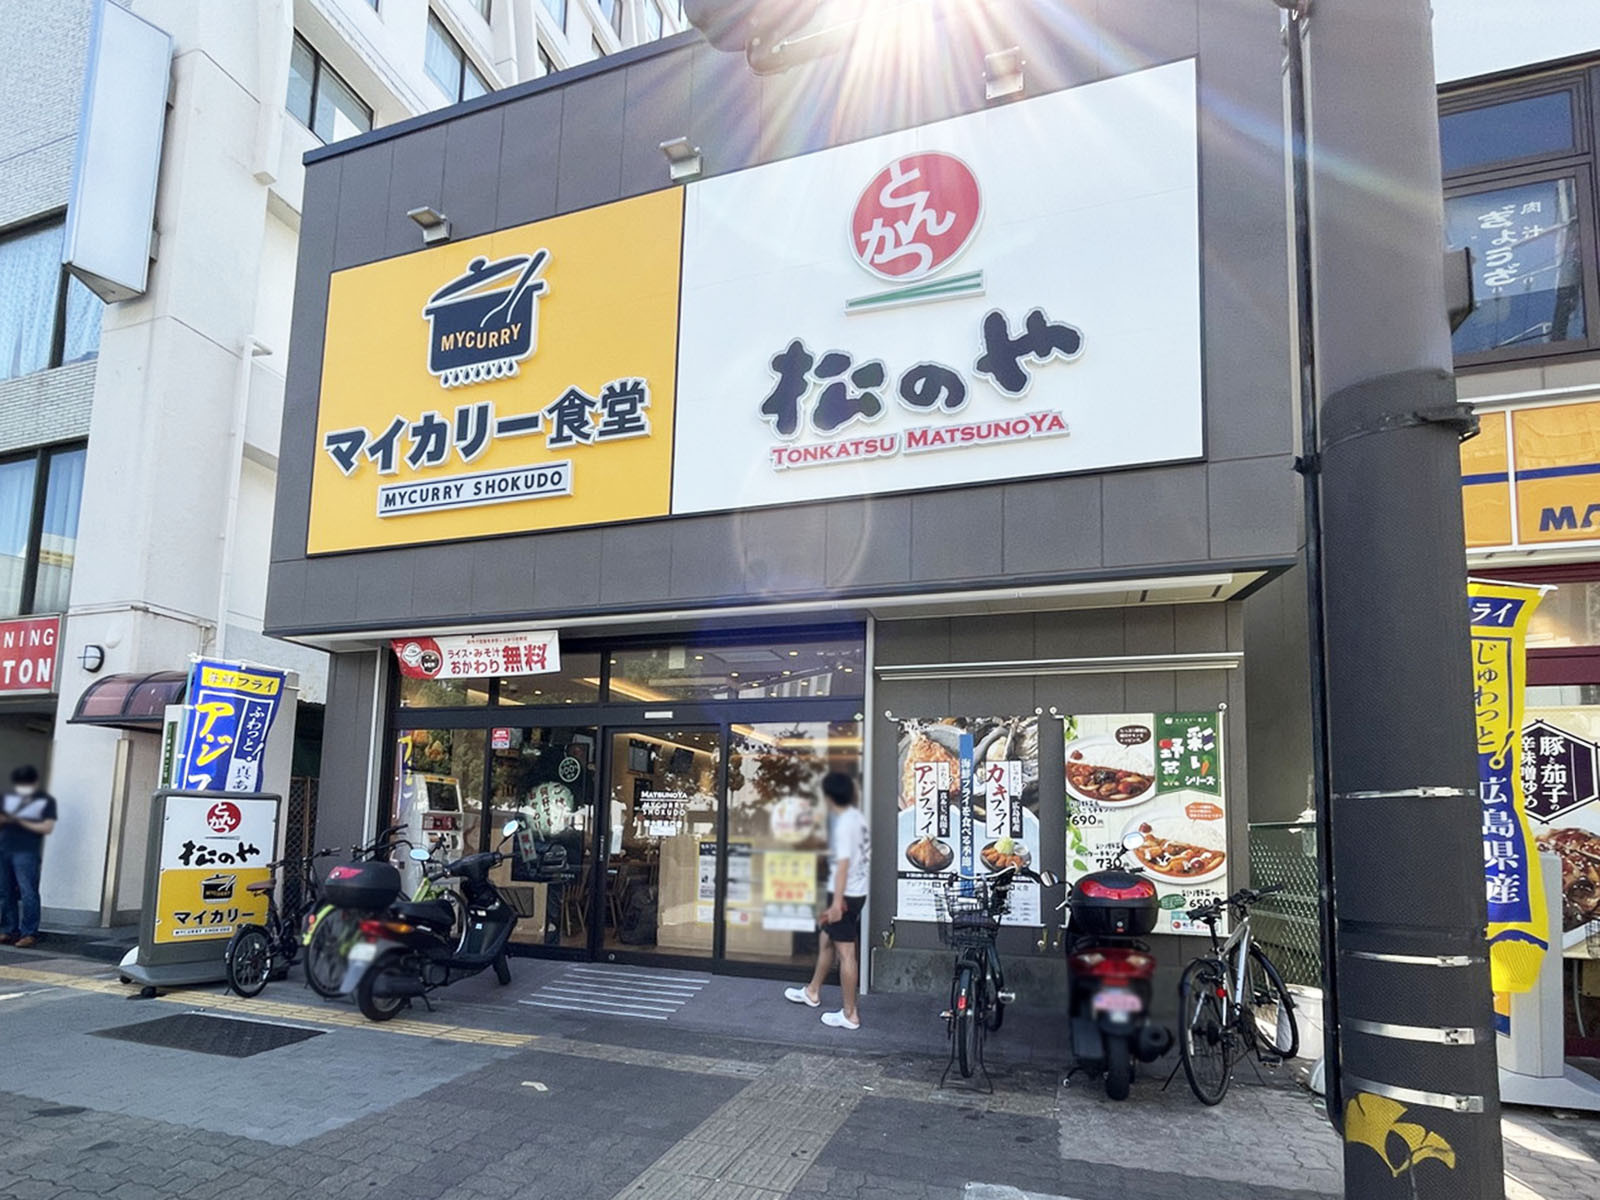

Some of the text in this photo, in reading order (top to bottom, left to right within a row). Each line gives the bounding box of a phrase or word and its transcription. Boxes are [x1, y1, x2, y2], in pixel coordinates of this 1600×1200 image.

[859, 159, 956, 278] とんかつ
[1520, 201, 1543, 239] 肉汁
[1478, 204, 1520, 287] ぎょうざ
[440, 323, 522, 352] MYCURRY
[760, 310, 1081, 435] 松のや
[325, 380, 648, 474] マイカリー食堂
[772, 413, 1066, 465] TONKATSU MATSUNOYA
[383, 470, 563, 508] MYCURRY SHOKUDO
[1471, 603, 1513, 624] ライ
[3, 628, 55, 649] NING
[447, 647, 500, 659] ライス・みそ汁
[3, 657, 52, 685] TON
[450, 658, 500, 675] おかわり
[502, 643, 548, 673] 無料
[914, 765, 936, 834] アジフライ
[985, 763, 1008, 835] カキフライ
[208, 802, 237, 833] とんかつ
[178, 839, 261, 866] 松のや
[1479, 776, 1521, 904] 広島県産
[174, 908, 255, 925] マイカリー
